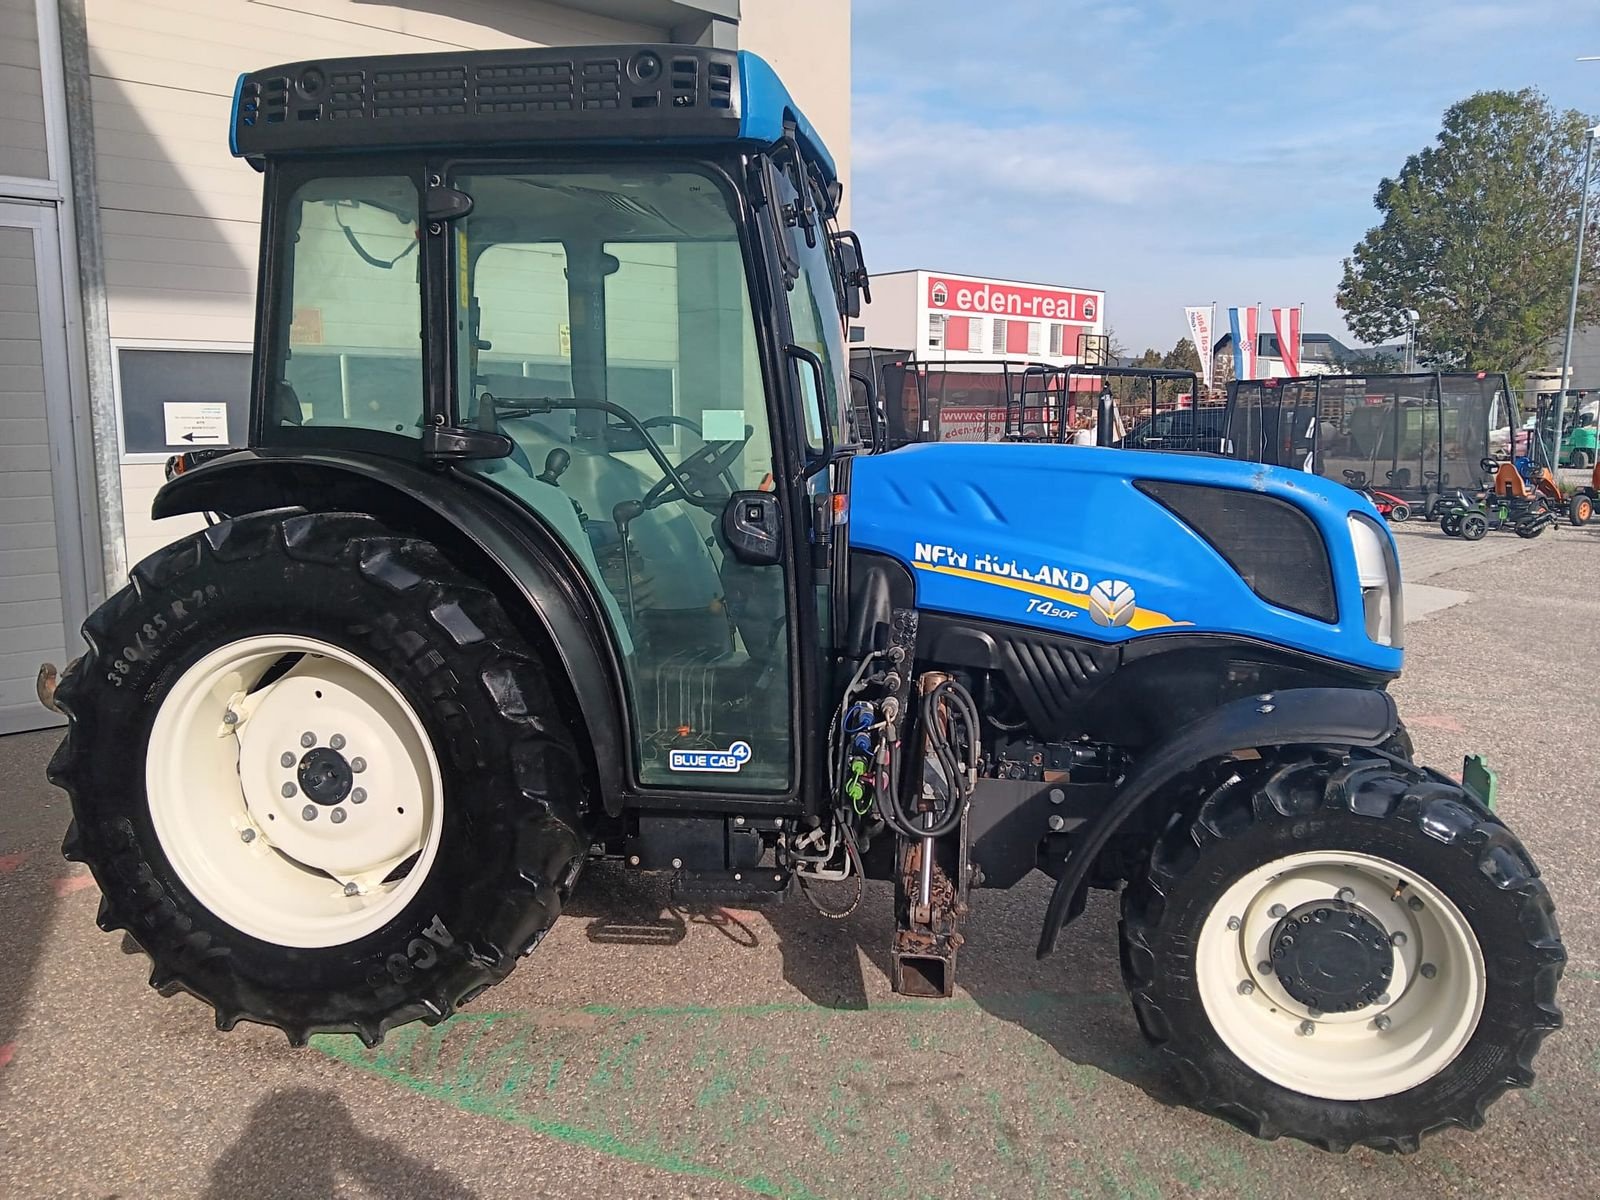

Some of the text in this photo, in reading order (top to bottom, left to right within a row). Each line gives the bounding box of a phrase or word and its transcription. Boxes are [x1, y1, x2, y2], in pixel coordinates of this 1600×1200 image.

[956, 285, 1075, 318] eden-real
[674, 754, 707, 766] BLUE
[709, 756, 736, 767] CAB
